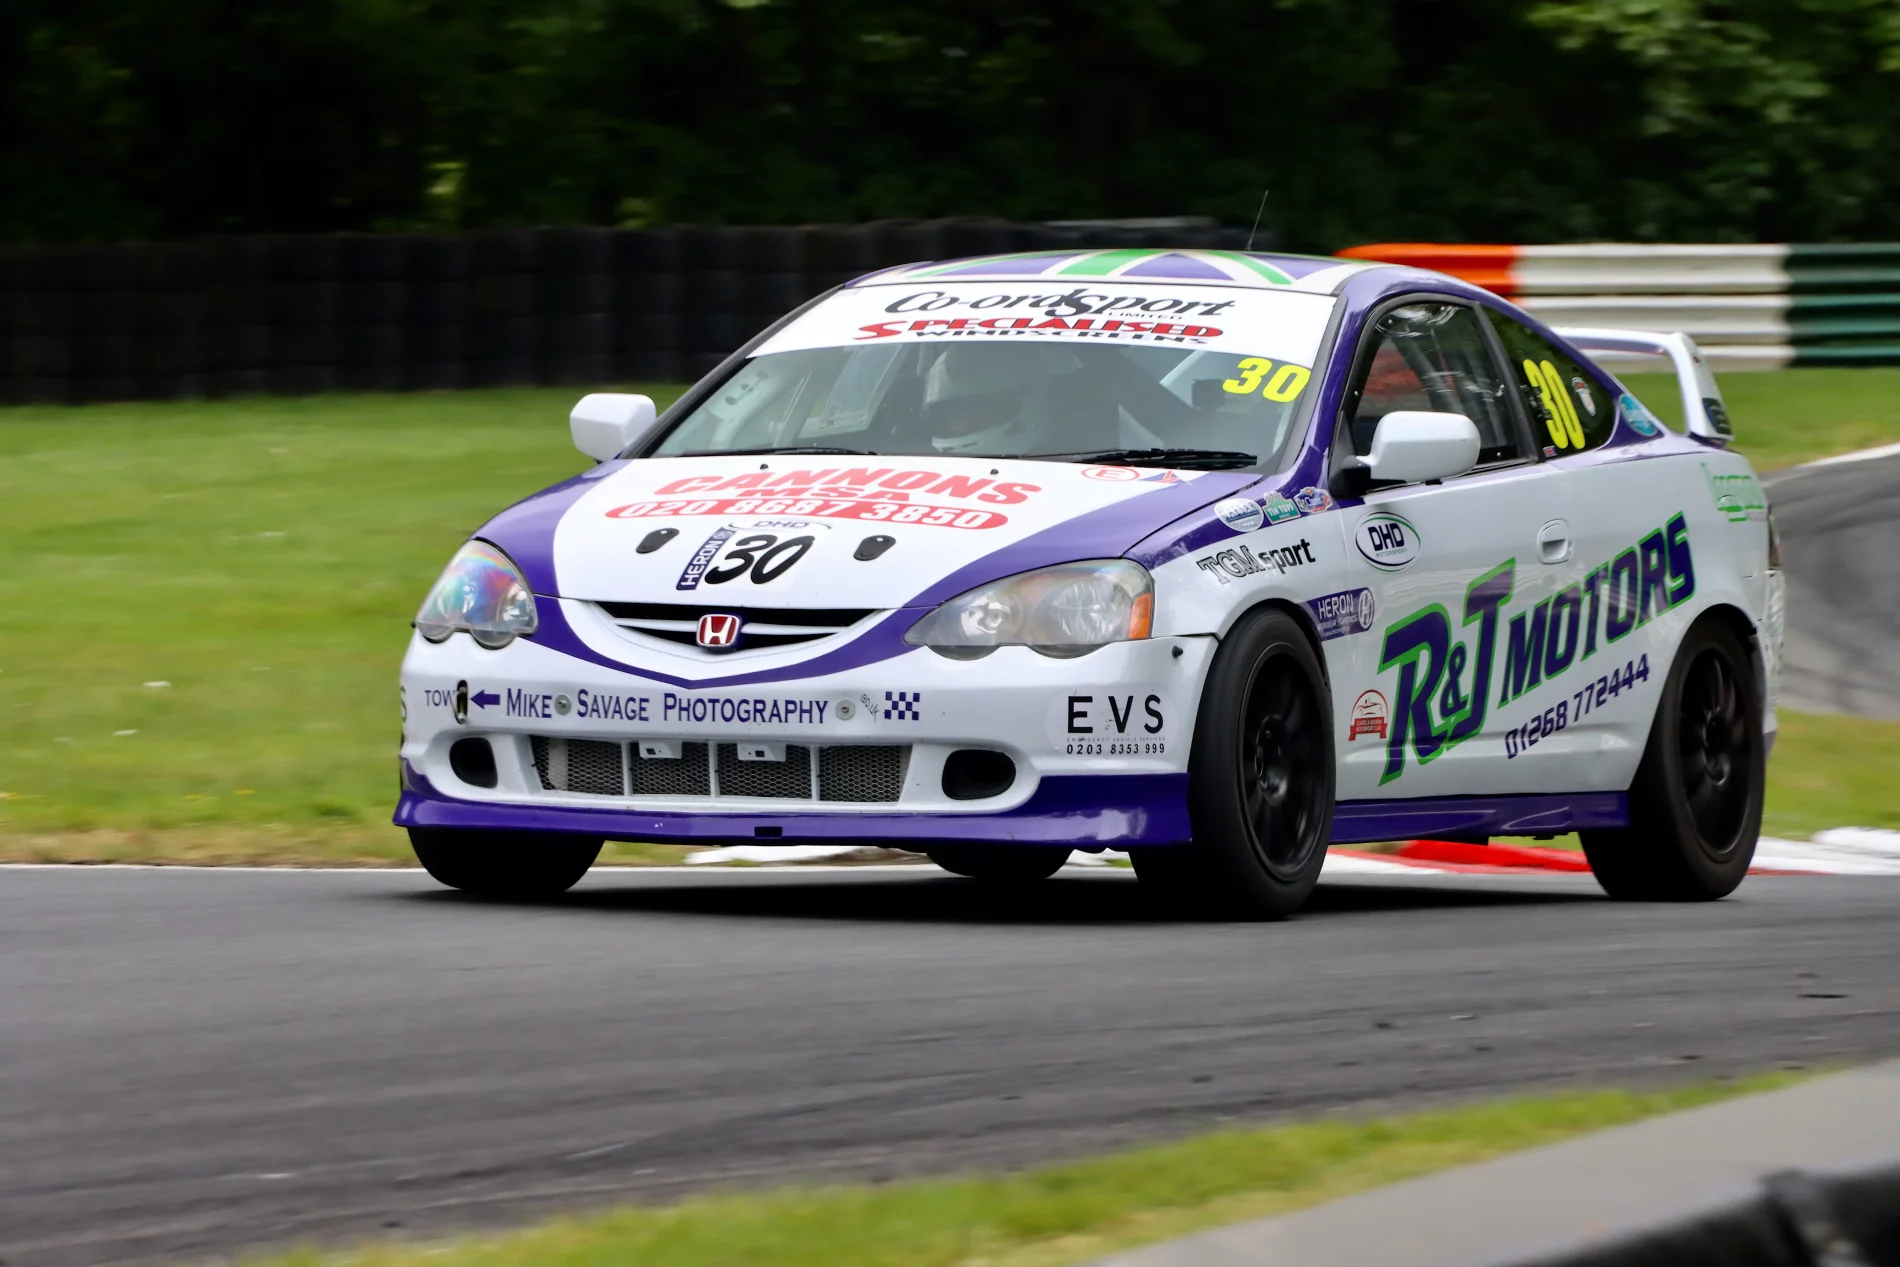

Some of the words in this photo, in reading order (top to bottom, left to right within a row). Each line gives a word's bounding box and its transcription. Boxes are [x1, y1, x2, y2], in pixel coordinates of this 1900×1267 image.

[852, 316, 1224, 340] SPECIALISED
[1108, 311, 1183, 320] LIMITED
[916, 329, 1209, 345] WINDSCREENS
[1222, 356, 1312, 403] 30
[1522, 358, 1586, 450] 30
[653, 467, 1043, 505] CANNONS
[735, 487, 910, 502] MSA
[618, 500, 719, 518] 020
[723, 499, 857, 517] 8687
[859, 502, 993, 528] 3850
[753, 520, 810, 529] DHD
[1367, 522, 1405, 551] DHD
[680, 540, 724, 586] HERON
[704, 534, 816, 584] 30
[1375, 547, 1408, 558] MOTORSPORT
[1317, 593, 1354, 620] HERON
[1377, 557, 1517, 787] R&J
[1497, 510, 1696, 710] MOTORS
[1505, 700, 1568, 760] 01268
[1573, 653, 1650, 722] 772444
[1066, 743, 1103, 755] 0203
[1110, 743, 1140, 755] 8353
[1145, 742, 1165, 754] 999
